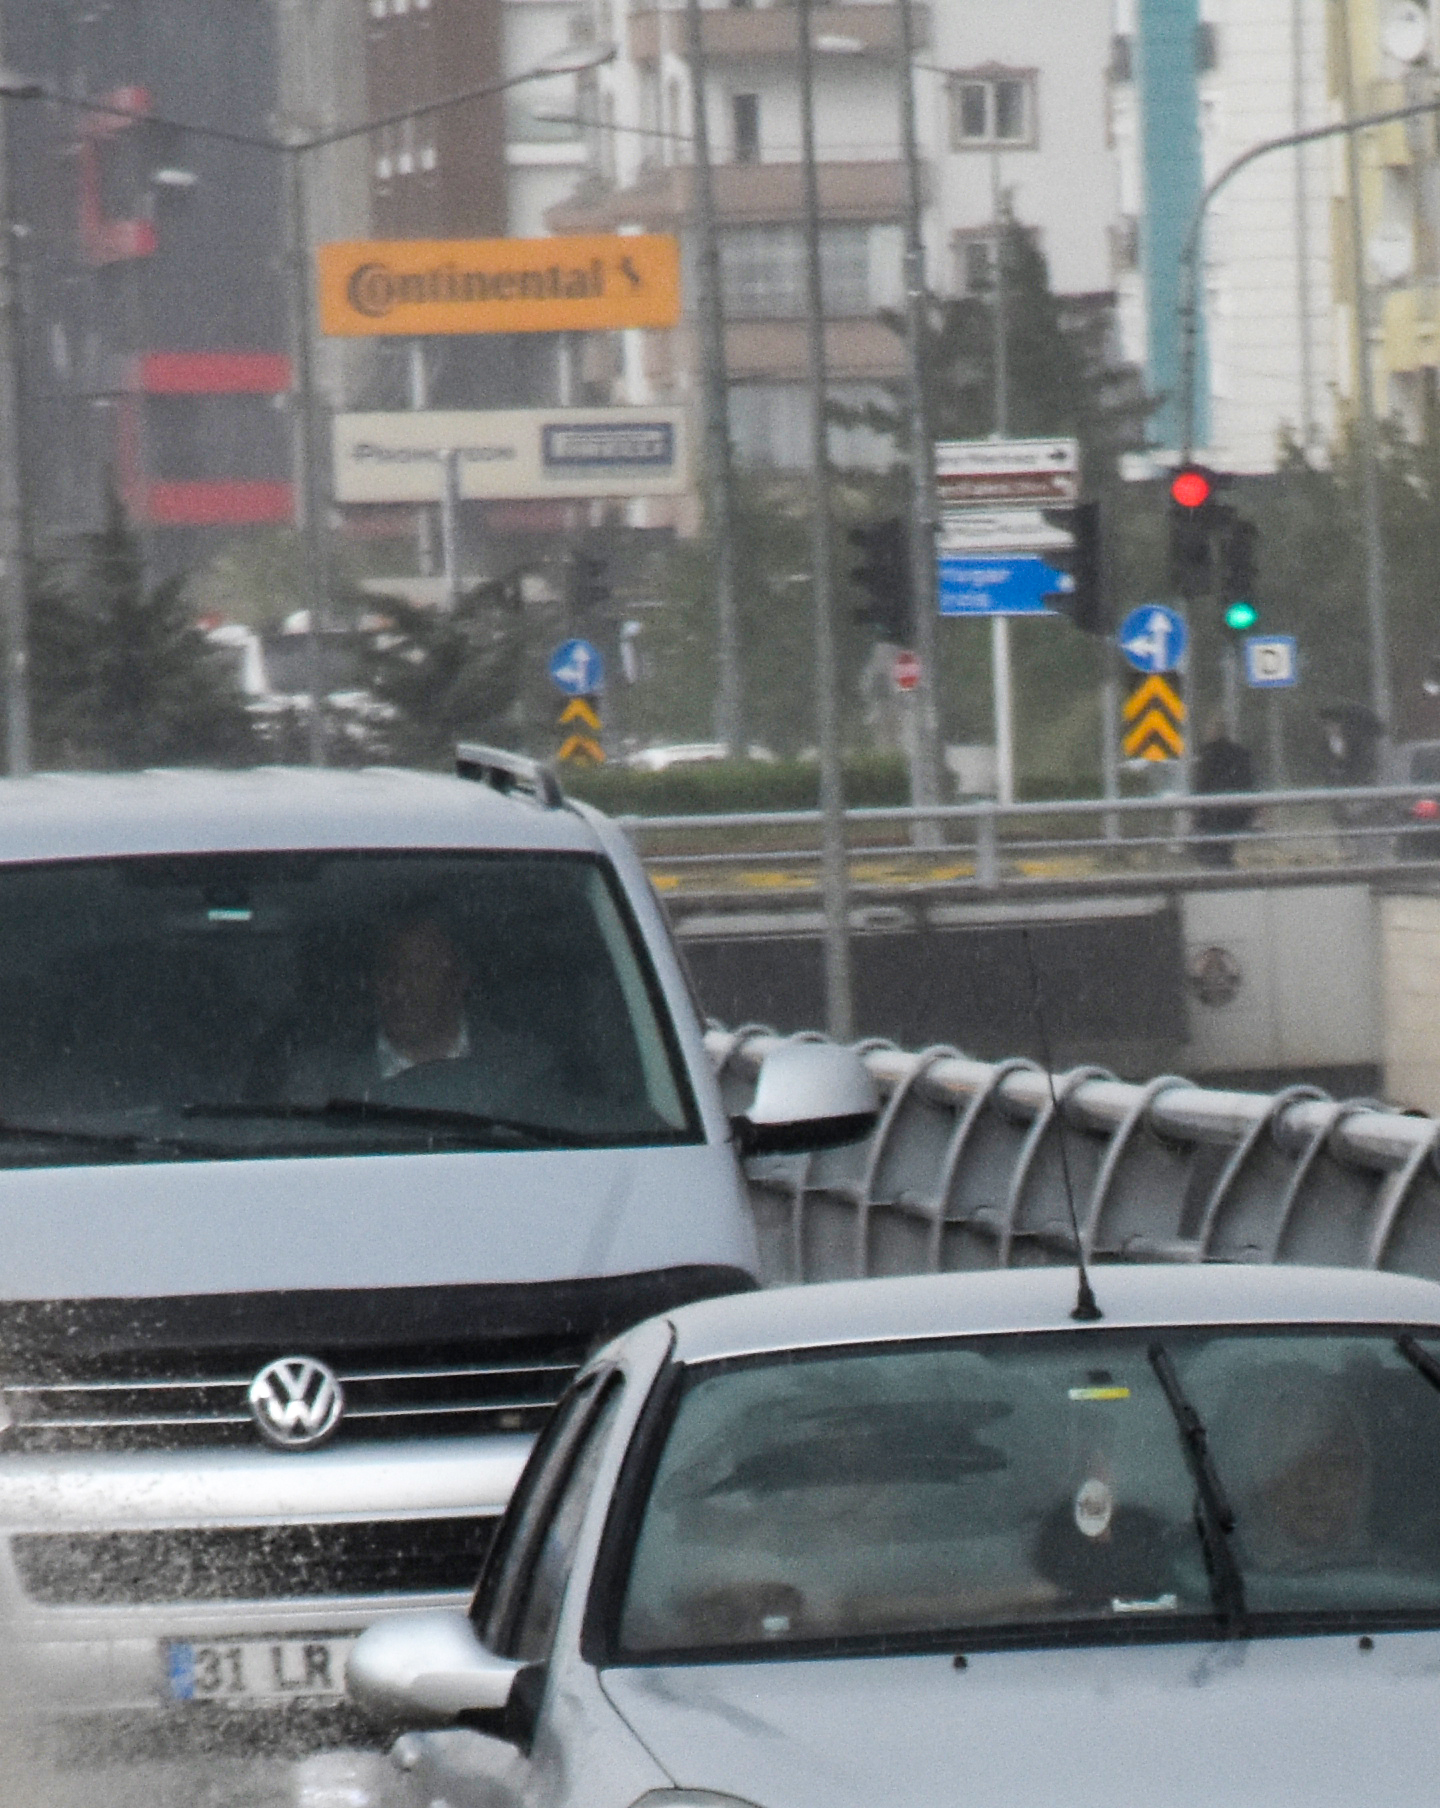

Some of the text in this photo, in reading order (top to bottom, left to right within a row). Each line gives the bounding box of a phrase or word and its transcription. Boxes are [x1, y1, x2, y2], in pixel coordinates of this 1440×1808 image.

[347, 258, 605, 318] Continental
[195, 1644, 333, 1693] 31 LR
